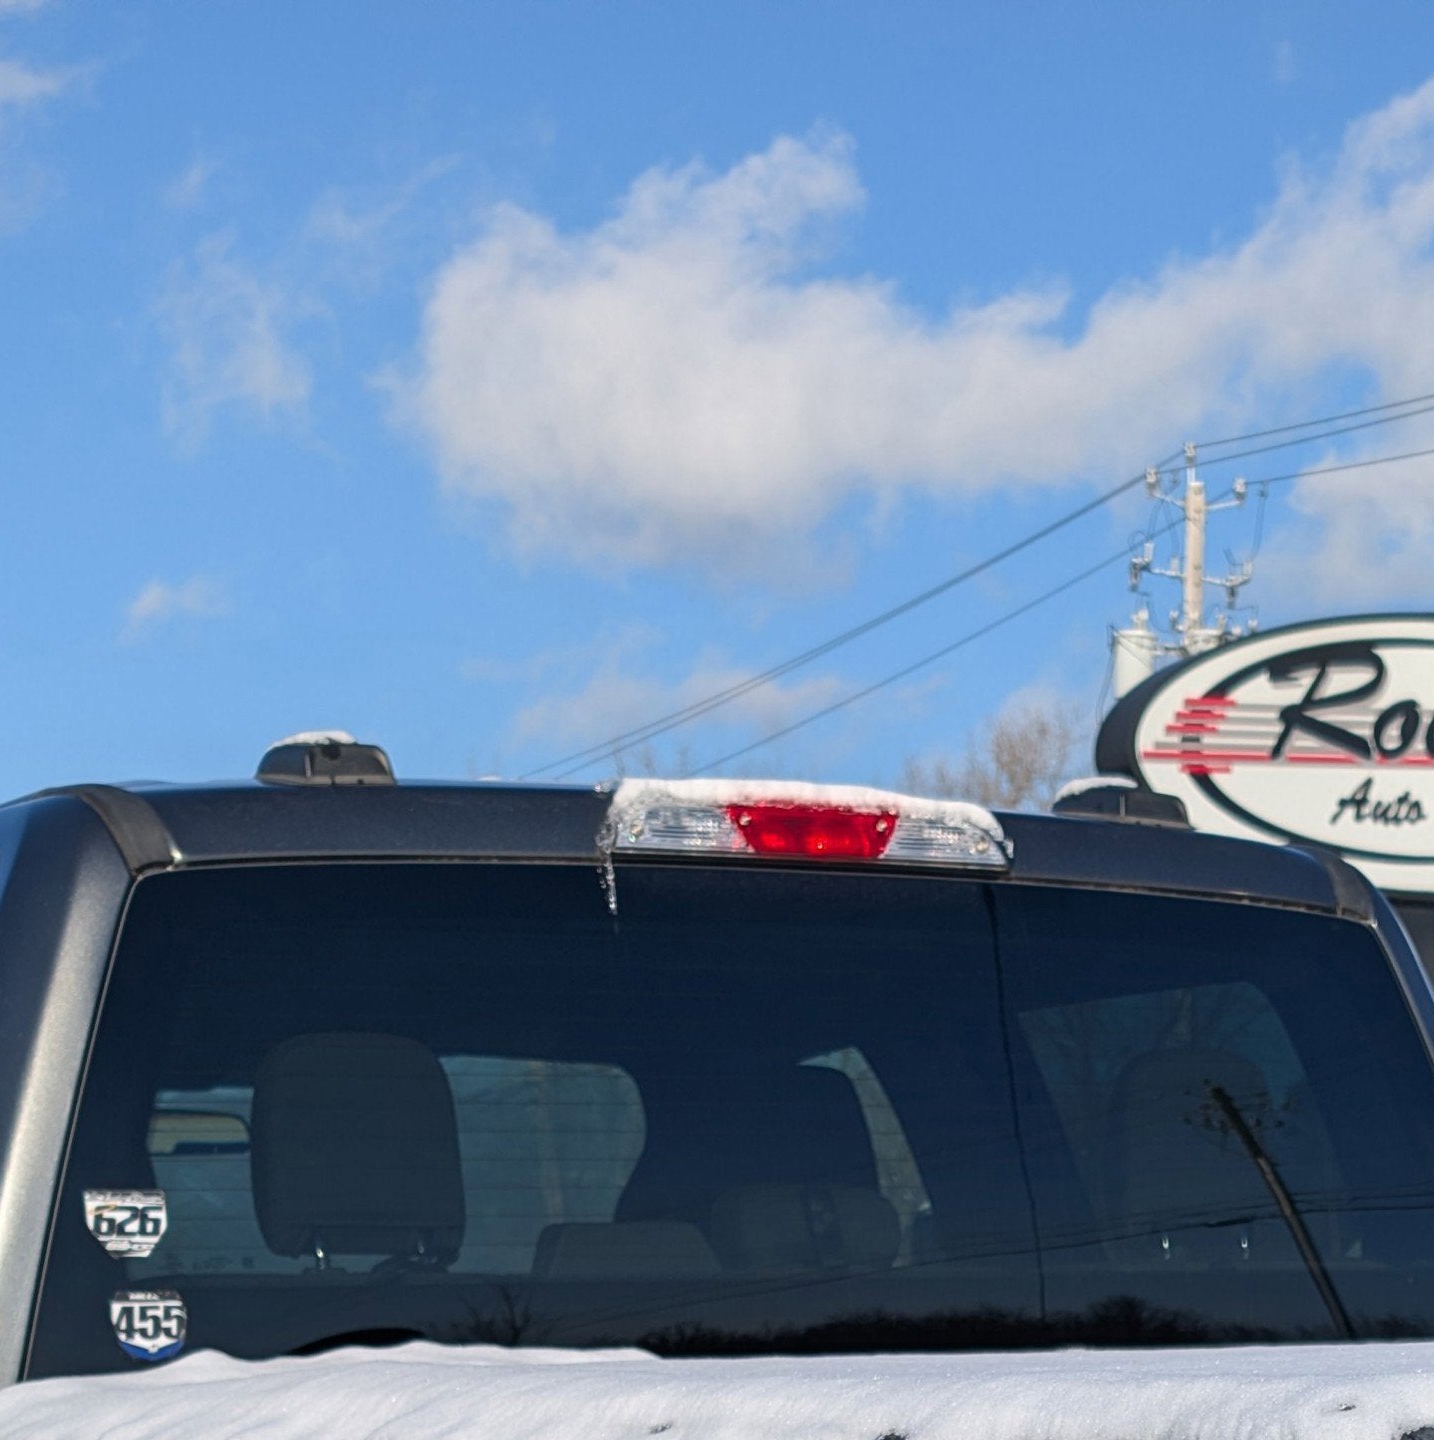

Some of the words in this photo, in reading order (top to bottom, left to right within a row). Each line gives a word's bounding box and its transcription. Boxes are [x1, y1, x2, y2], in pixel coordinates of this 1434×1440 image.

[1329, 776, 1427, 827] Auto
[93, 1203, 163, 1237] 626
[114, 1304, 186, 1340] 455
